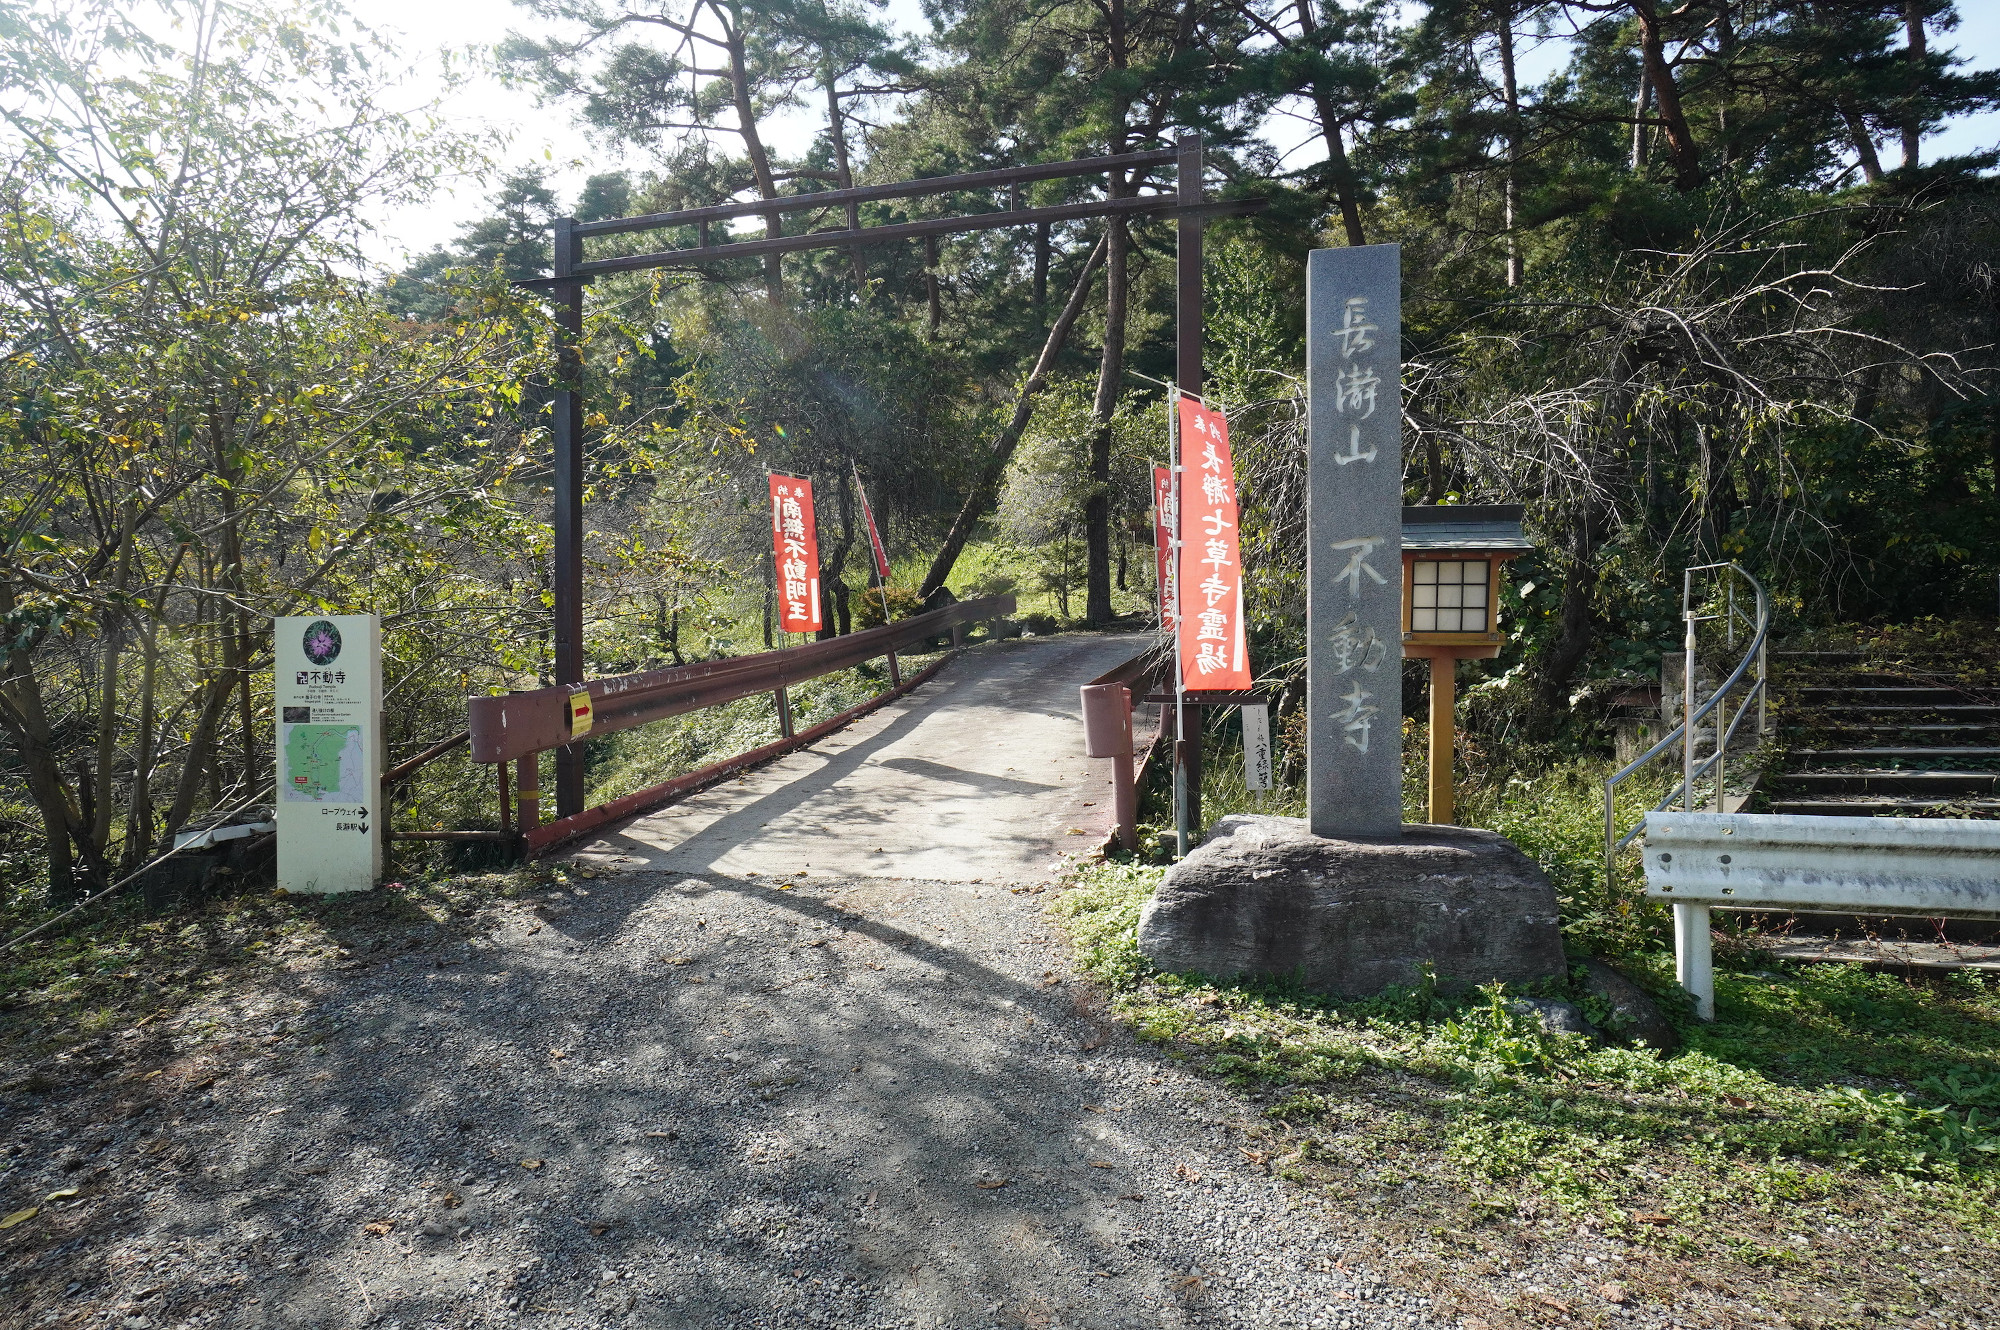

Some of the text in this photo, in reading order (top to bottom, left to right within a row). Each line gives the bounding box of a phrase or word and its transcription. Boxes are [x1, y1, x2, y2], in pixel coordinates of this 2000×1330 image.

[1327, 535, 1388, 755] 不動寺
[310, 670, 346, 684] 不動寺
[321, 807, 357, 816] ロープウェイ
[336, 822, 358, 831] 長瀞駅
